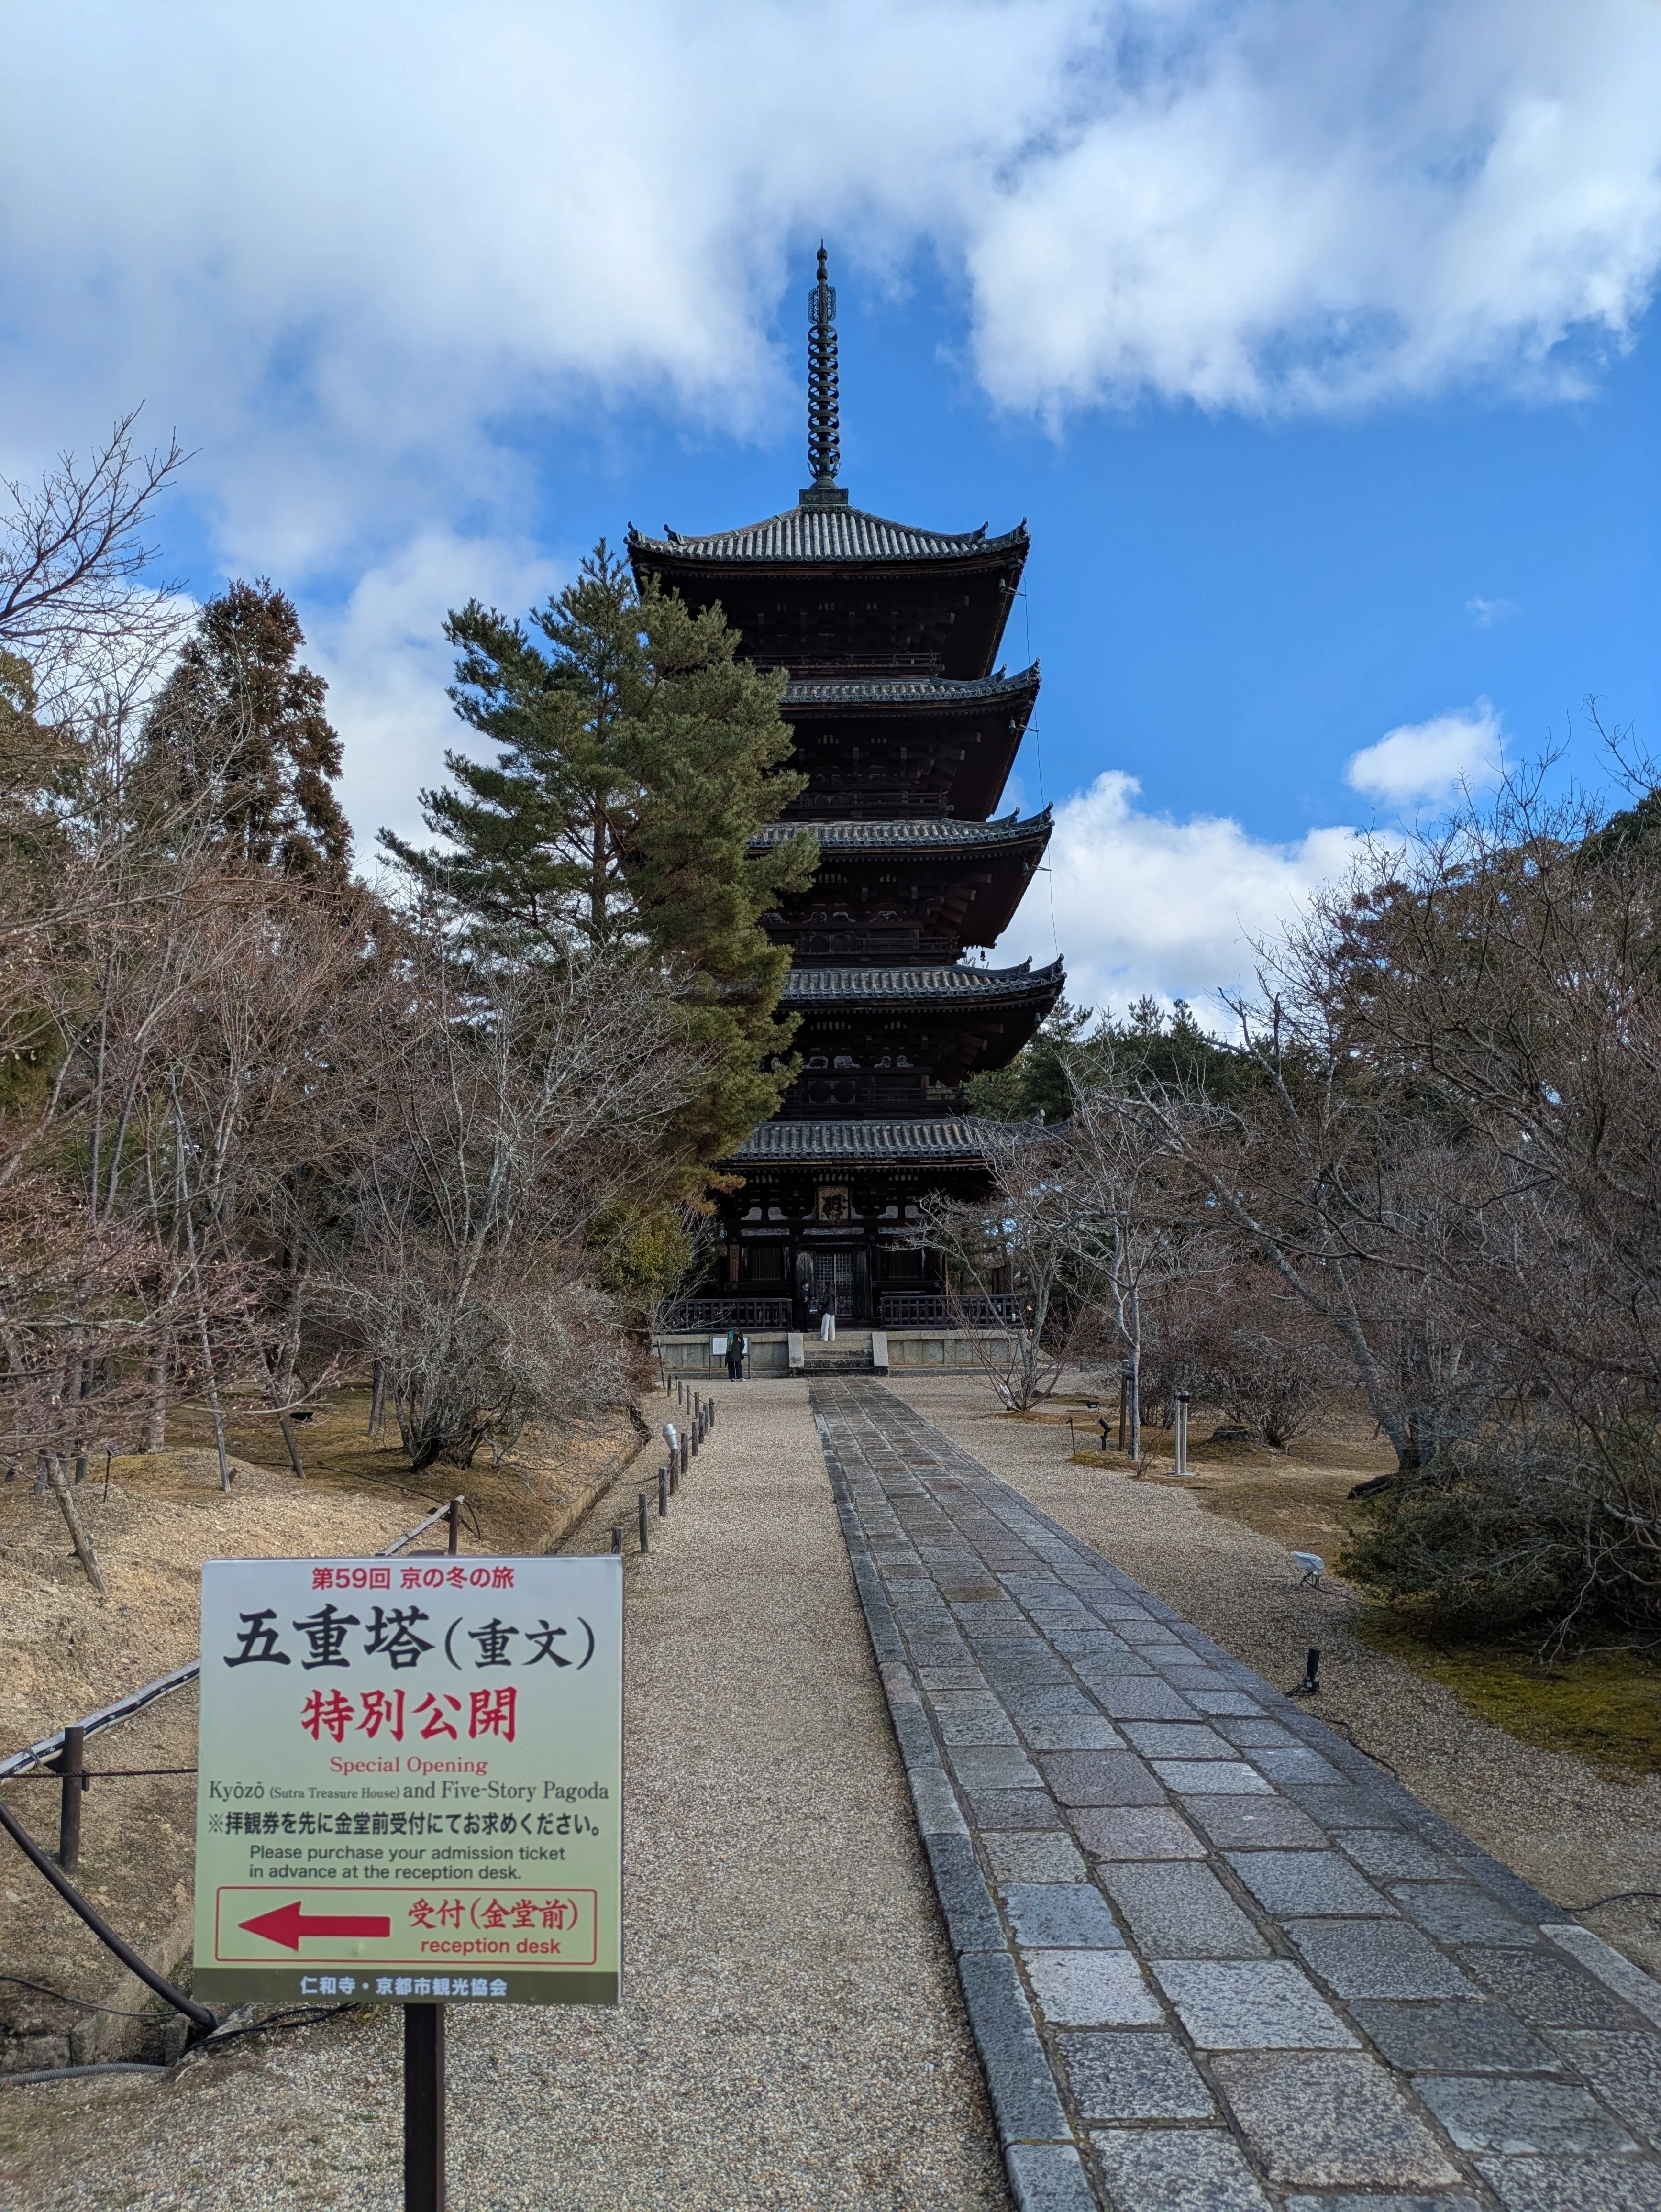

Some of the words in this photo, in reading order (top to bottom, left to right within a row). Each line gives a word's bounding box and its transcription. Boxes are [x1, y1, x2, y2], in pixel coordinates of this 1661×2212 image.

[311, 1567, 391, 1591] 第59回
[400, 1566, 515, 1590] 京の冬の旅
[223, 1603, 595, 1671] 五重塔（重文）
[300, 1686, 517, 1743] 特別公開
[331, 1756, 400, 1776] Special
[407, 1756, 488, 1776] Opening
[209, 1781, 265, 1802] Kyōzō
[270, 1787, 305, 1799] (Sutra
[309, 1787, 358, 1798] Treasure
[362, 1787, 400, 1799] House)
[403, 1781, 435, 1798] and
[441, 1781, 536, 1803] Five-Story
[543, 1781, 609, 1803] Pagoda
[250, 1845, 302, 1859] Please
[308, 1845, 384, 1861] purchase
[389, 1849, 426, 1862] your
[431, 1846, 513, 1860] admission
[518, 1846, 565, 1860] ticket
[249, 1864, 263, 1878] in
[269, 1864, 337, 1878] advance
[342, 1866, 358, 1878] at
[363, 1865, 389, 1879] the
[395, 1865, 473, 1882] reception
[478, 1865, 521, 1879] desk.
[408, 1897, 578, 1931] 受付（金堂前）
[421, 1937, 510, 1956] reception
[516, 1938, 561, 1954] desk
[300, 1976, 507, 1997] 仁和寺・京都市観光協会
